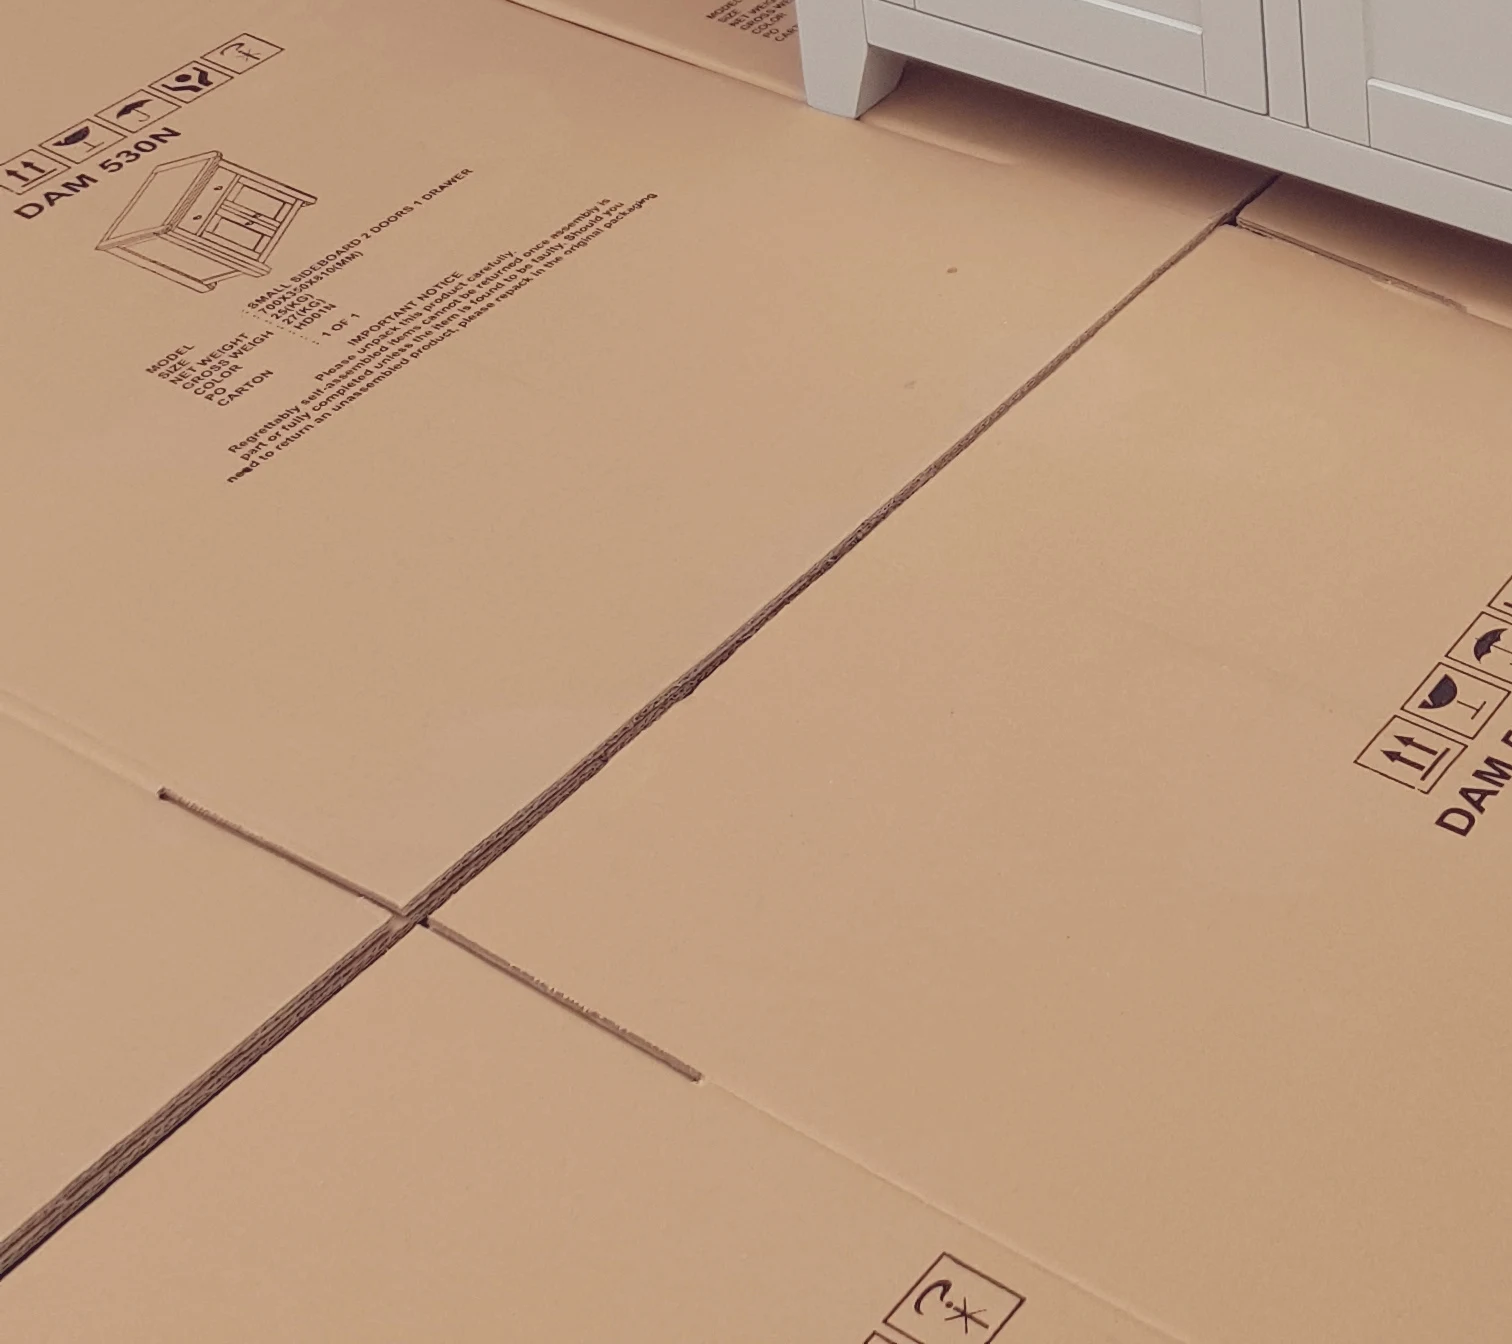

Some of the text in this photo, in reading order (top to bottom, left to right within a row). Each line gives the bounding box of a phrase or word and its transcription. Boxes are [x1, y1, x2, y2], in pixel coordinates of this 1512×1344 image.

[11, 126, 183, 220] DAM 530N
[144, 345, 195, 374] MODEL
[247, 283, 293, 308] SMALL
[290, 238, 361, 282] SIDEBOARD
[369, 205, 414, 232] DOORS
[421, 167, 474, 199] DRAWER
[314, 250, 516, 380] Please unpack this product carefully.
[348, 271, 463, 345] IMPORTANT NOTICE
[156, 359, 189, 379] SIZE
[167, 292, 315, 384] NET WEIGHT 25(KG)
[181, 297, 327, 389] GROSS WEIGH 27(KG)
[216, 369, 274, 406] CARTON
[331, 317, 349, 331] OF
[227, 198, 610, 452] Regrettably self-assembled items cannot be returned once assembly is
[192, 364, 242, 395] COLOR
[203, 387, 226, 401] PO
